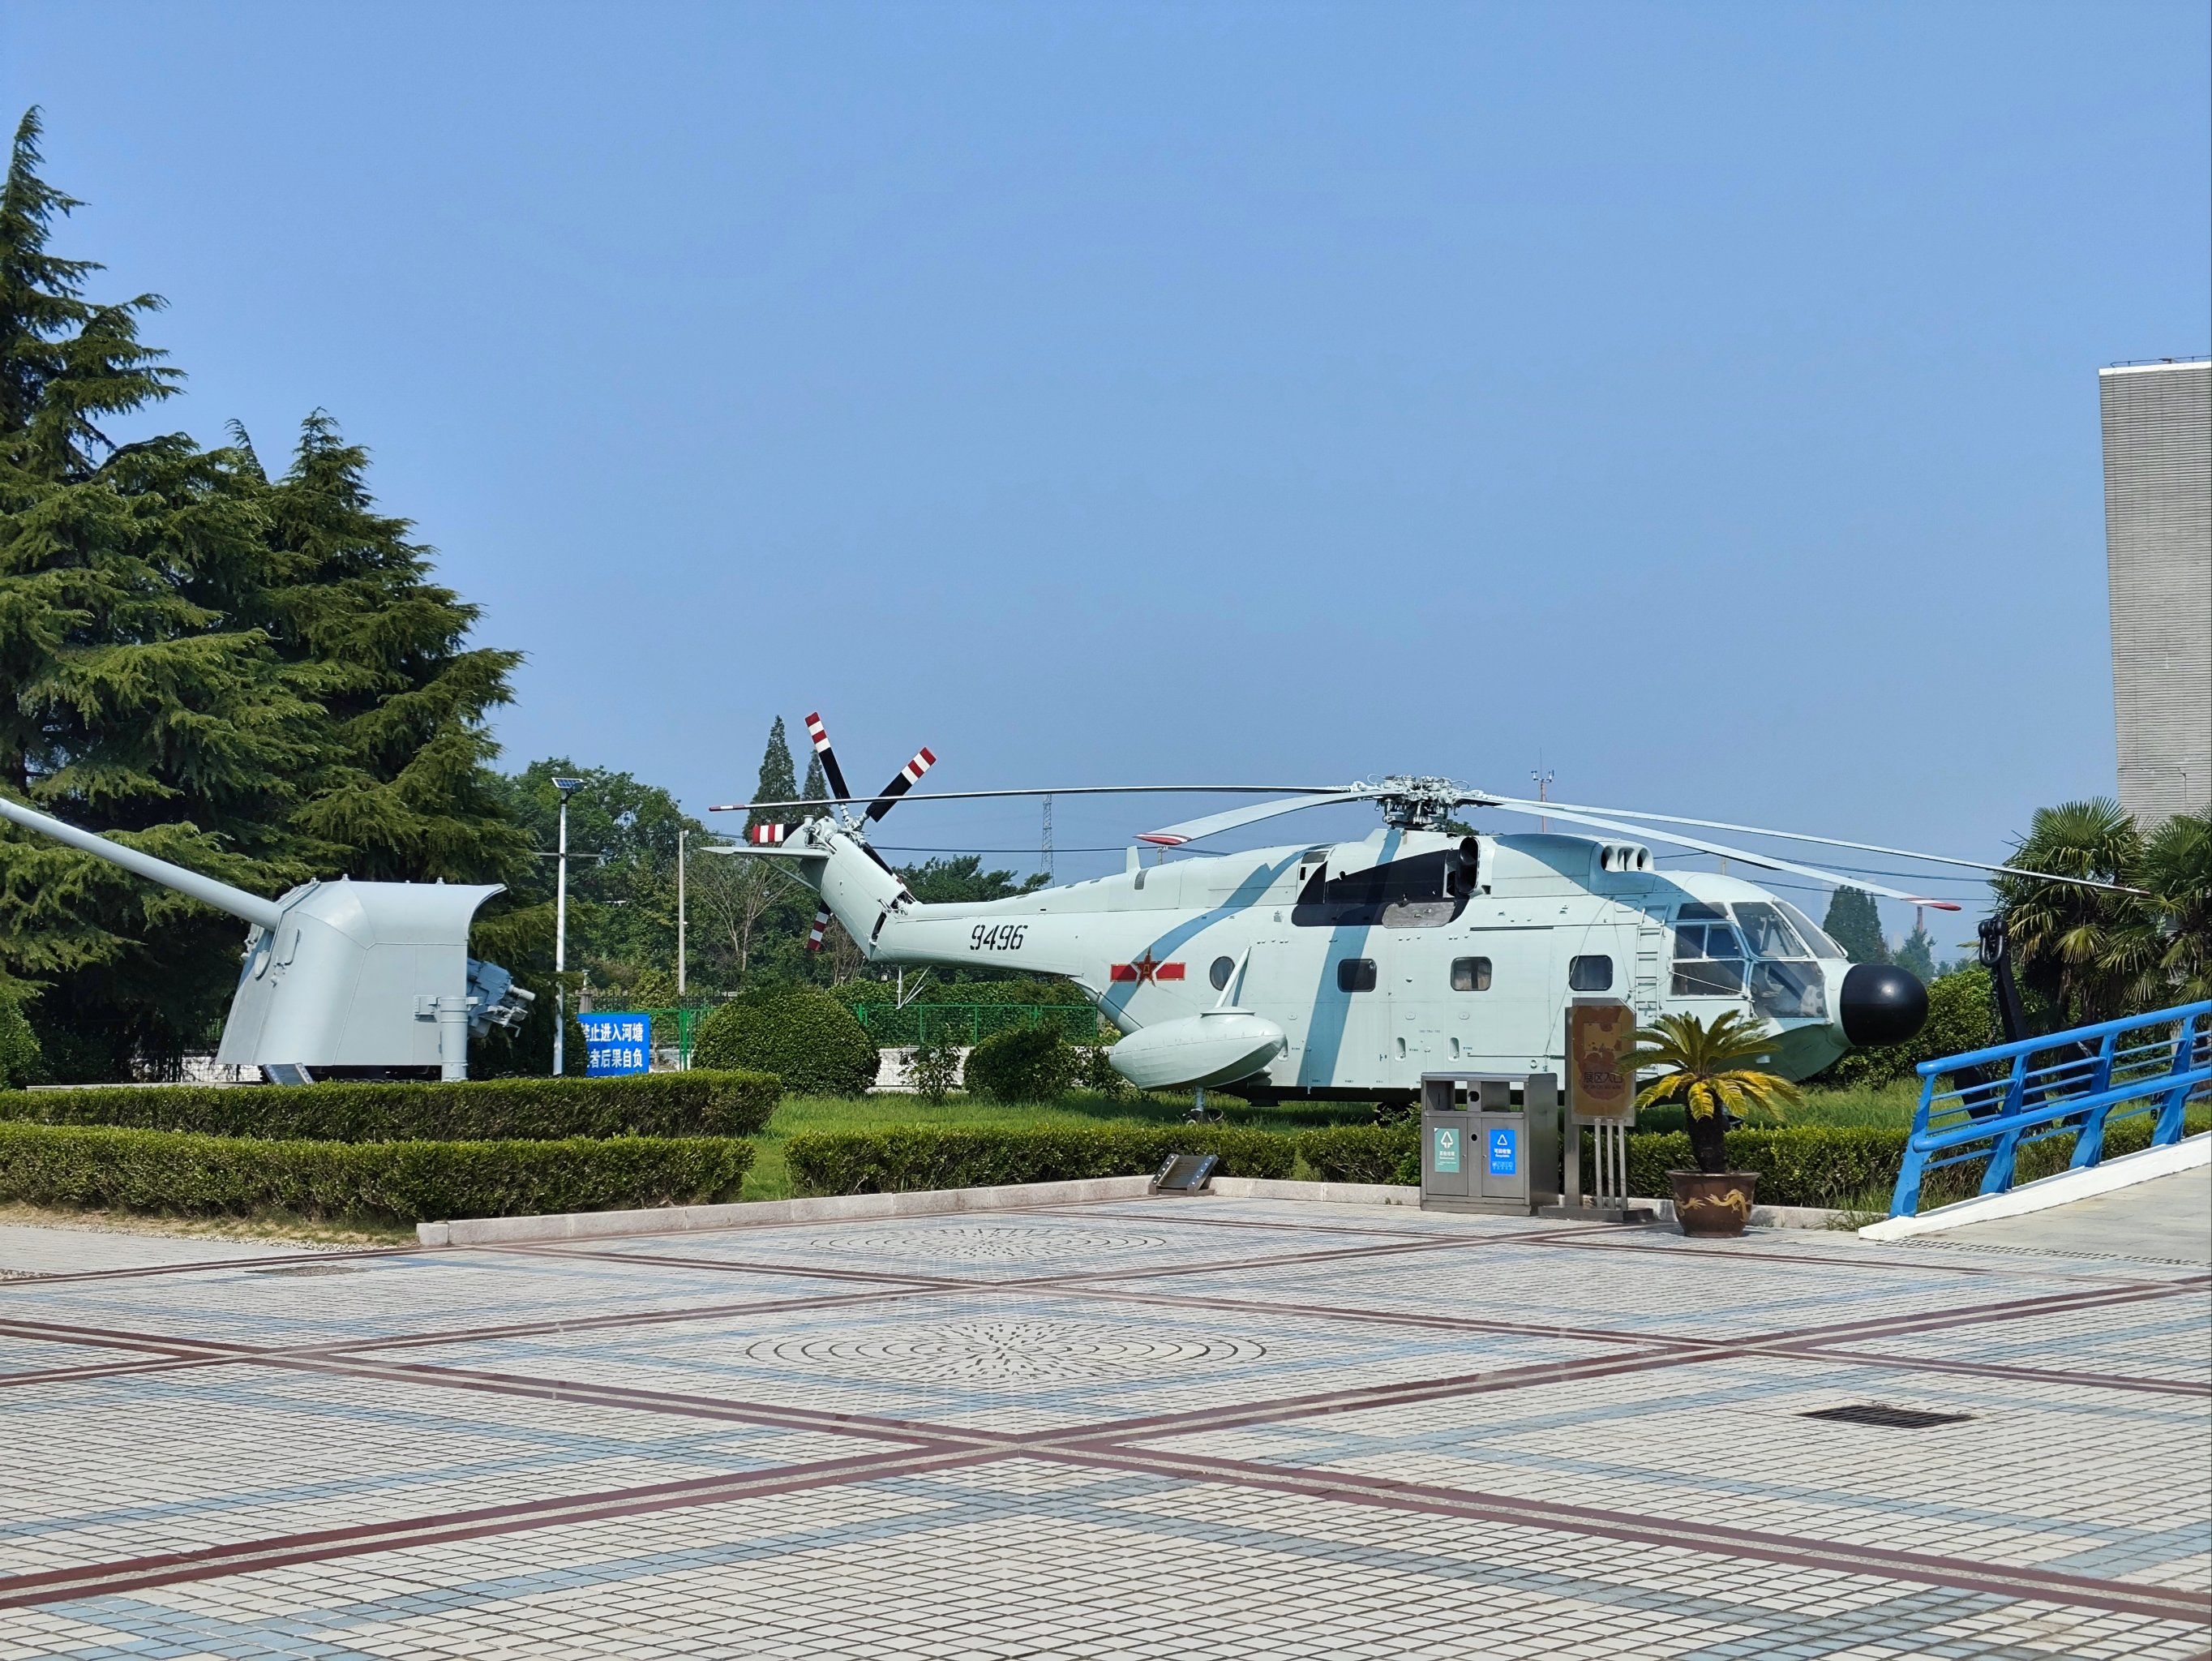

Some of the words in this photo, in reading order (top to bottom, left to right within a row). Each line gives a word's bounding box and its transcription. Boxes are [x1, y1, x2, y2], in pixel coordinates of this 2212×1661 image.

[970, 925, 1028, 951] 9496
[587, 1048, 643, 1068] 者后果自负
[1584, 1071, 1623, 1084] 展区入口
